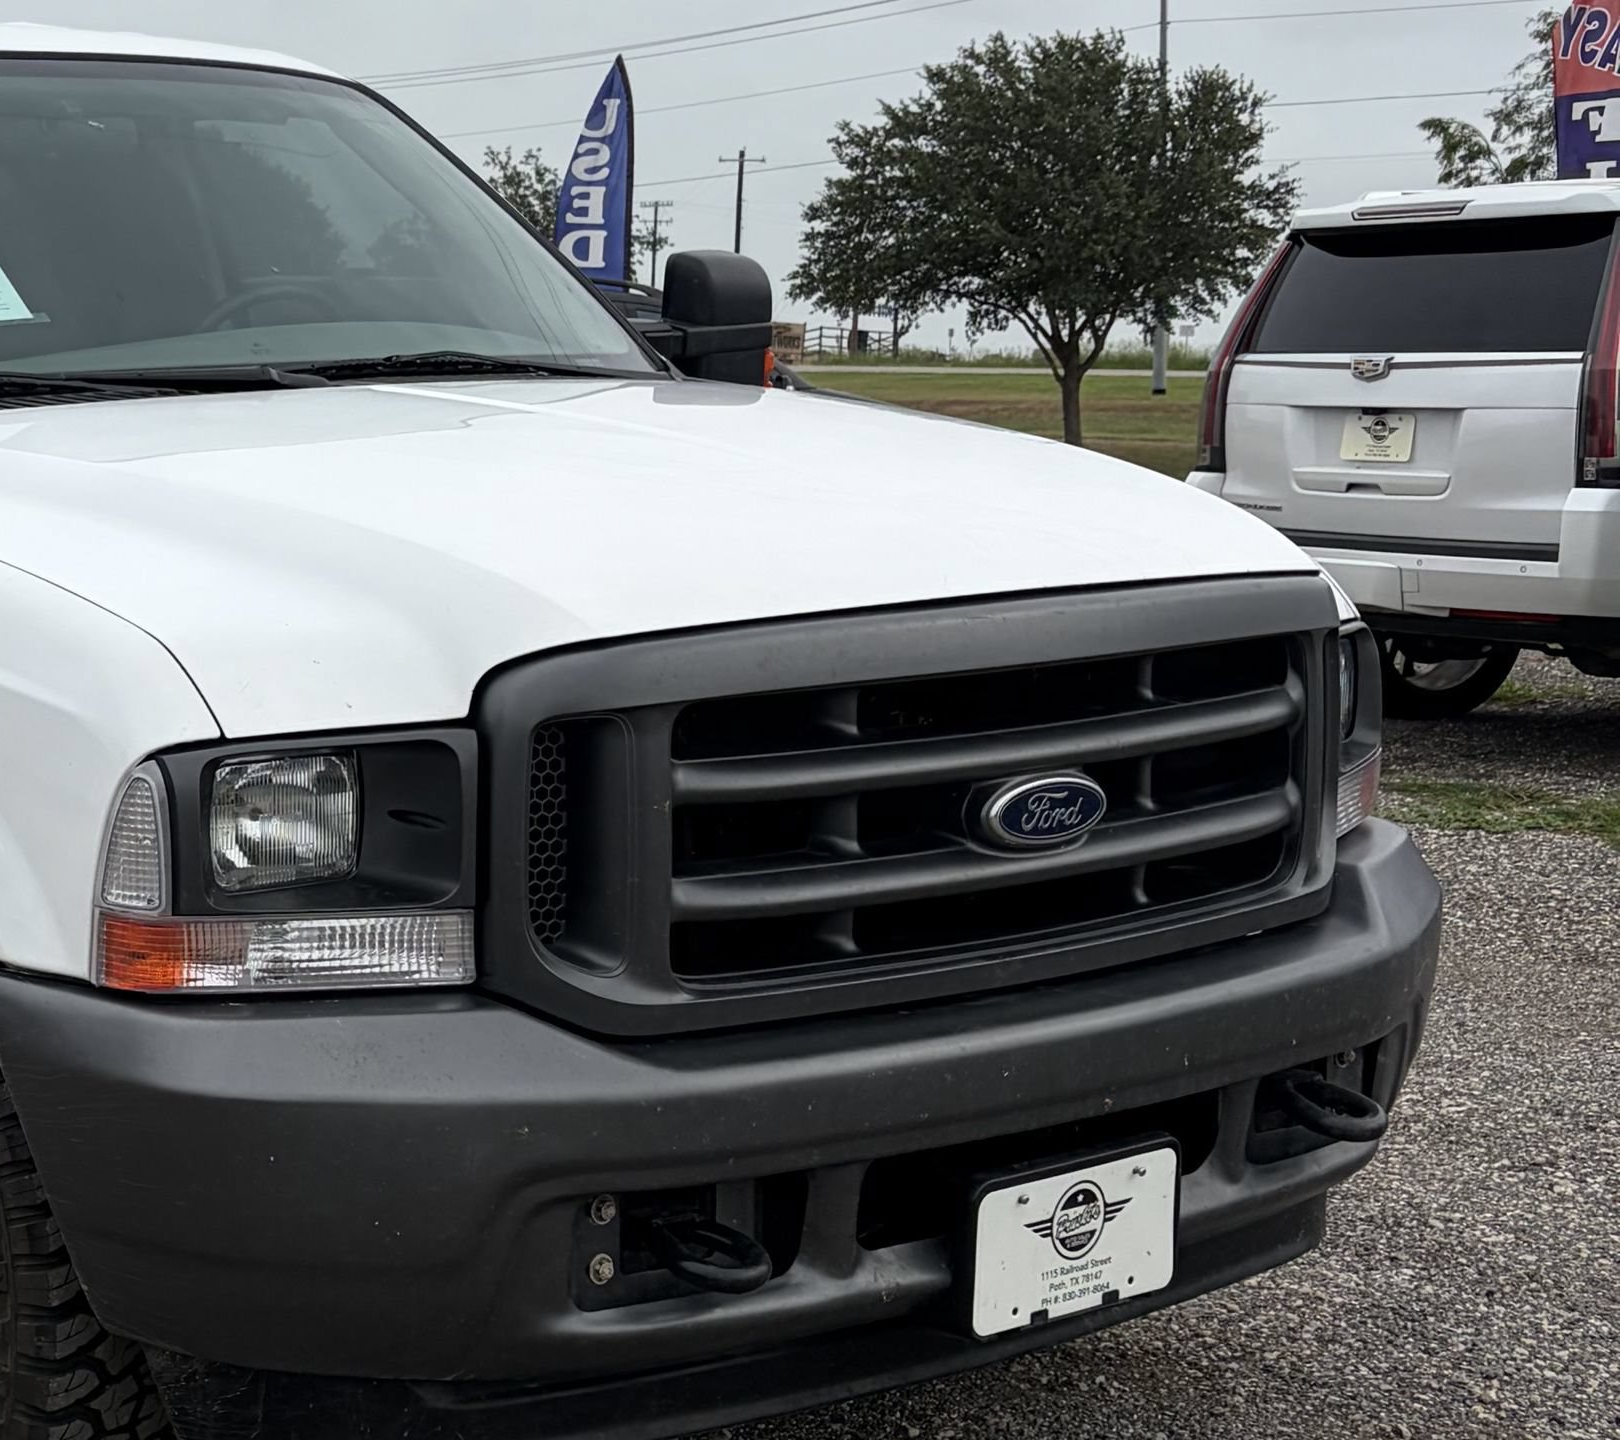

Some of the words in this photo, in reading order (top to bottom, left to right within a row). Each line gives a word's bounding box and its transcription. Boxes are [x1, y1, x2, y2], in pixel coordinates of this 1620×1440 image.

[1021, 790, 1085, 832] Ford
[1041, 1268, 1059, 1281] 1115
[1060, 1260, 1089, 1276] Railroad
[1090, 1256, 1112, 1269] Street
[1070, 1276, 1080, 1287] TX
[1041, 1296, 1053, 1308] PH
